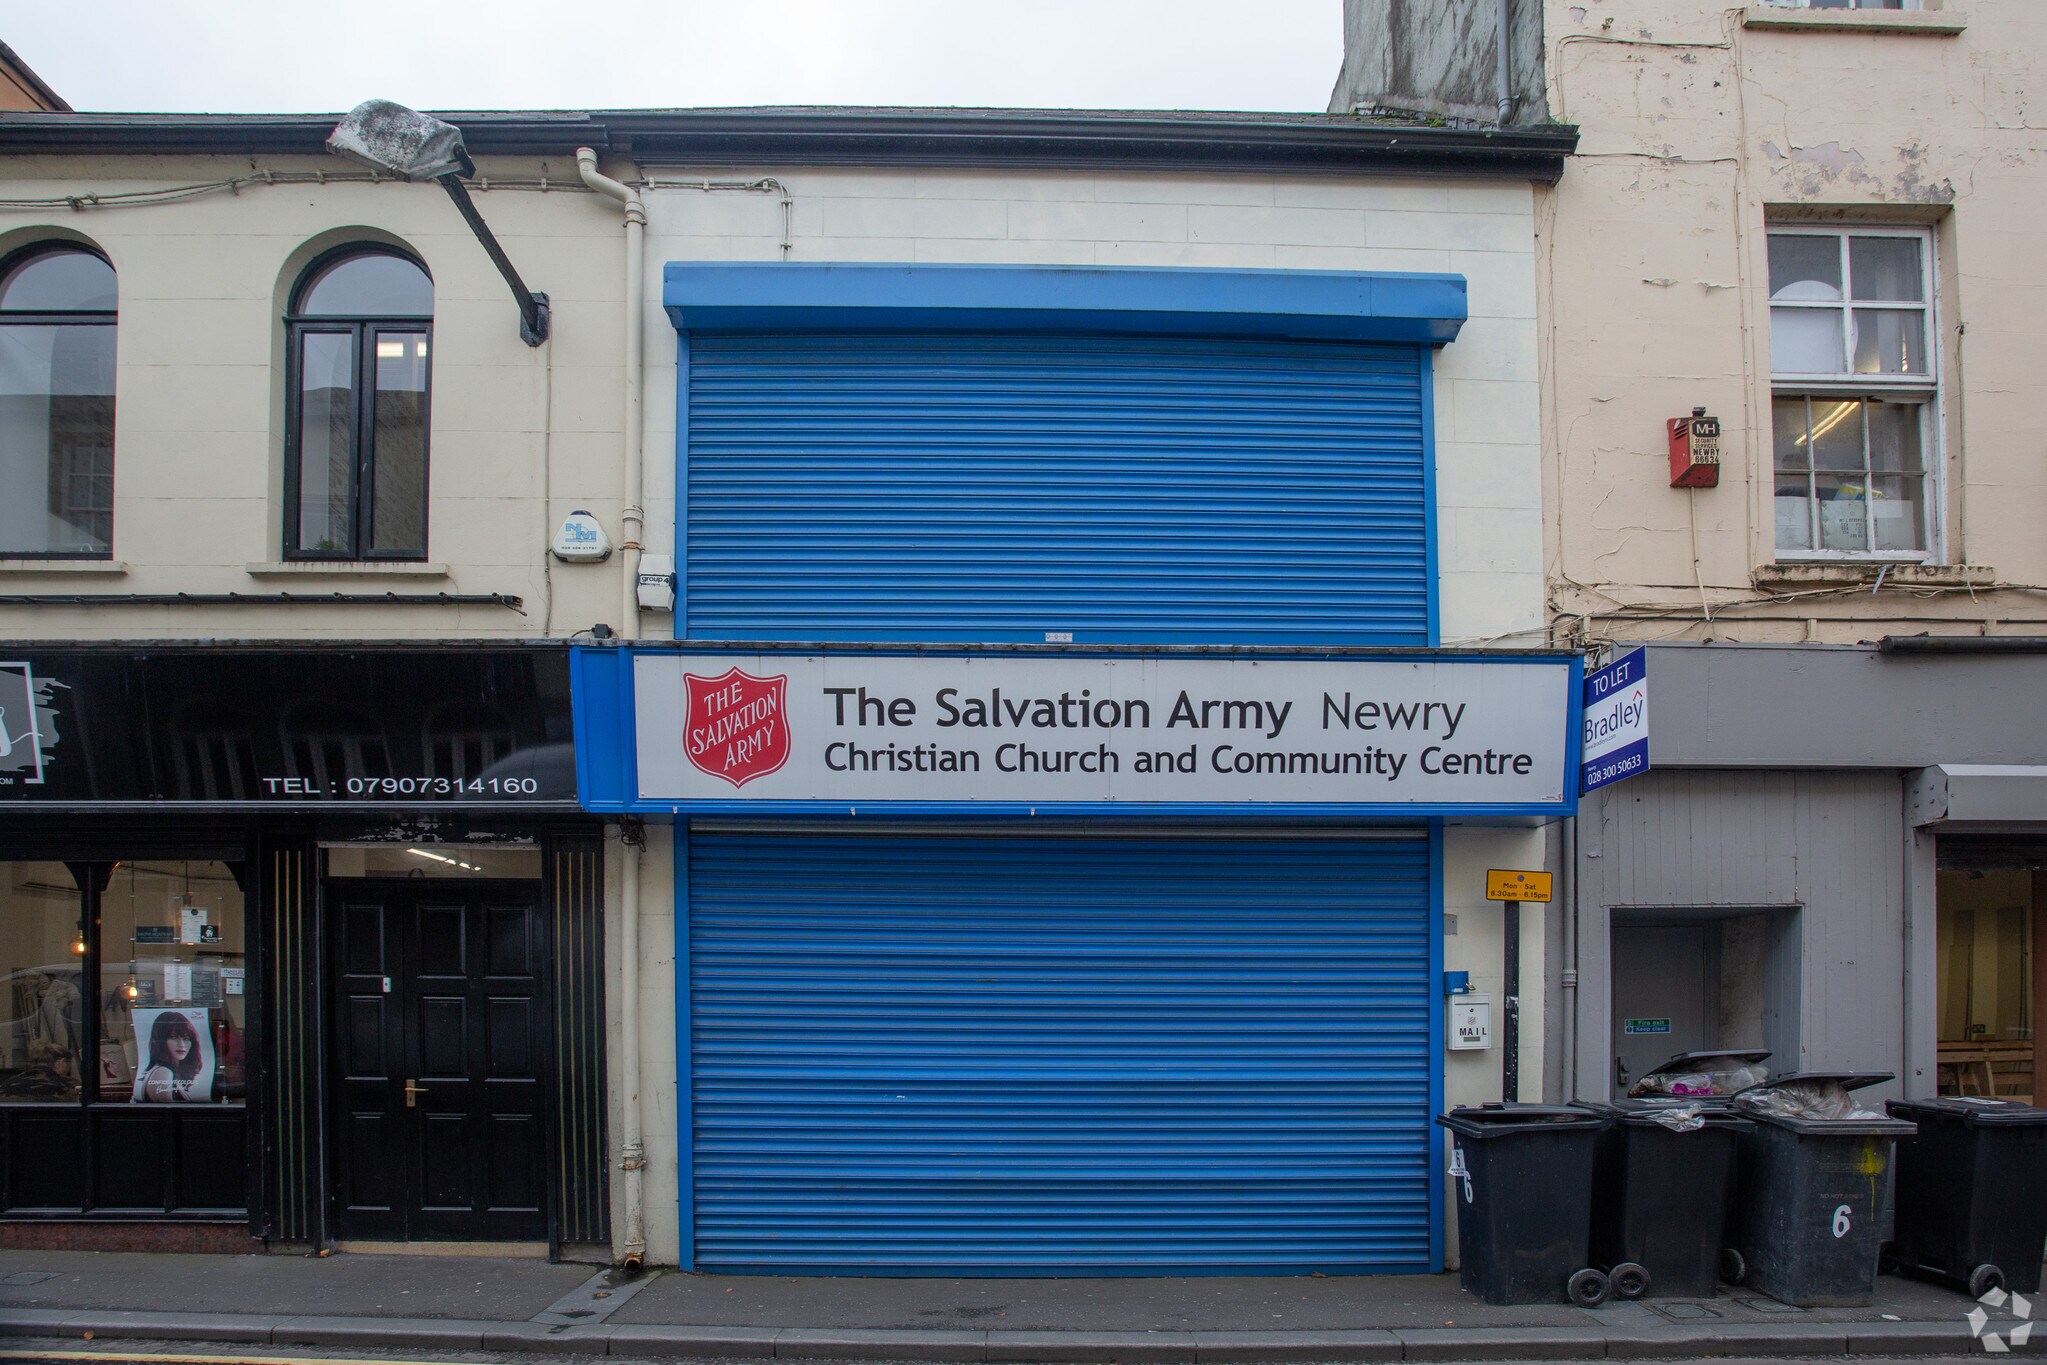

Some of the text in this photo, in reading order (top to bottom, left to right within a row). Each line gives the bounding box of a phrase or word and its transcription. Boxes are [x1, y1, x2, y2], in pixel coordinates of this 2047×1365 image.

[1696, 423, 1716, 434] MH
[641, 576, 663, 584] group
[1593, 661, 1631, 696] TO LET
[703, 680, 743, 717] THE
[823, 686, 1466, 740] The Salvation Army Newry
[691, 686, 777, 755] SALVATION
[1584, 699, 1644, 744] Bradley
[723, 719, 775, 772] ARMY
[824, 741, 1533, 782] Christian Church and Community Centre
[262, 777, 321, 794] TEL
[346, 777, 538, 794] 07907314160
[1587, 754, 1642, 786] 028 300 50633
[1523, 891, 1549, 899] 6.15pm
[1459, 1027, 1487, 1036] MAIL
[1463, 1170, 1474, 1204] 6
[1832, 1204, 1852, 1238] 6
